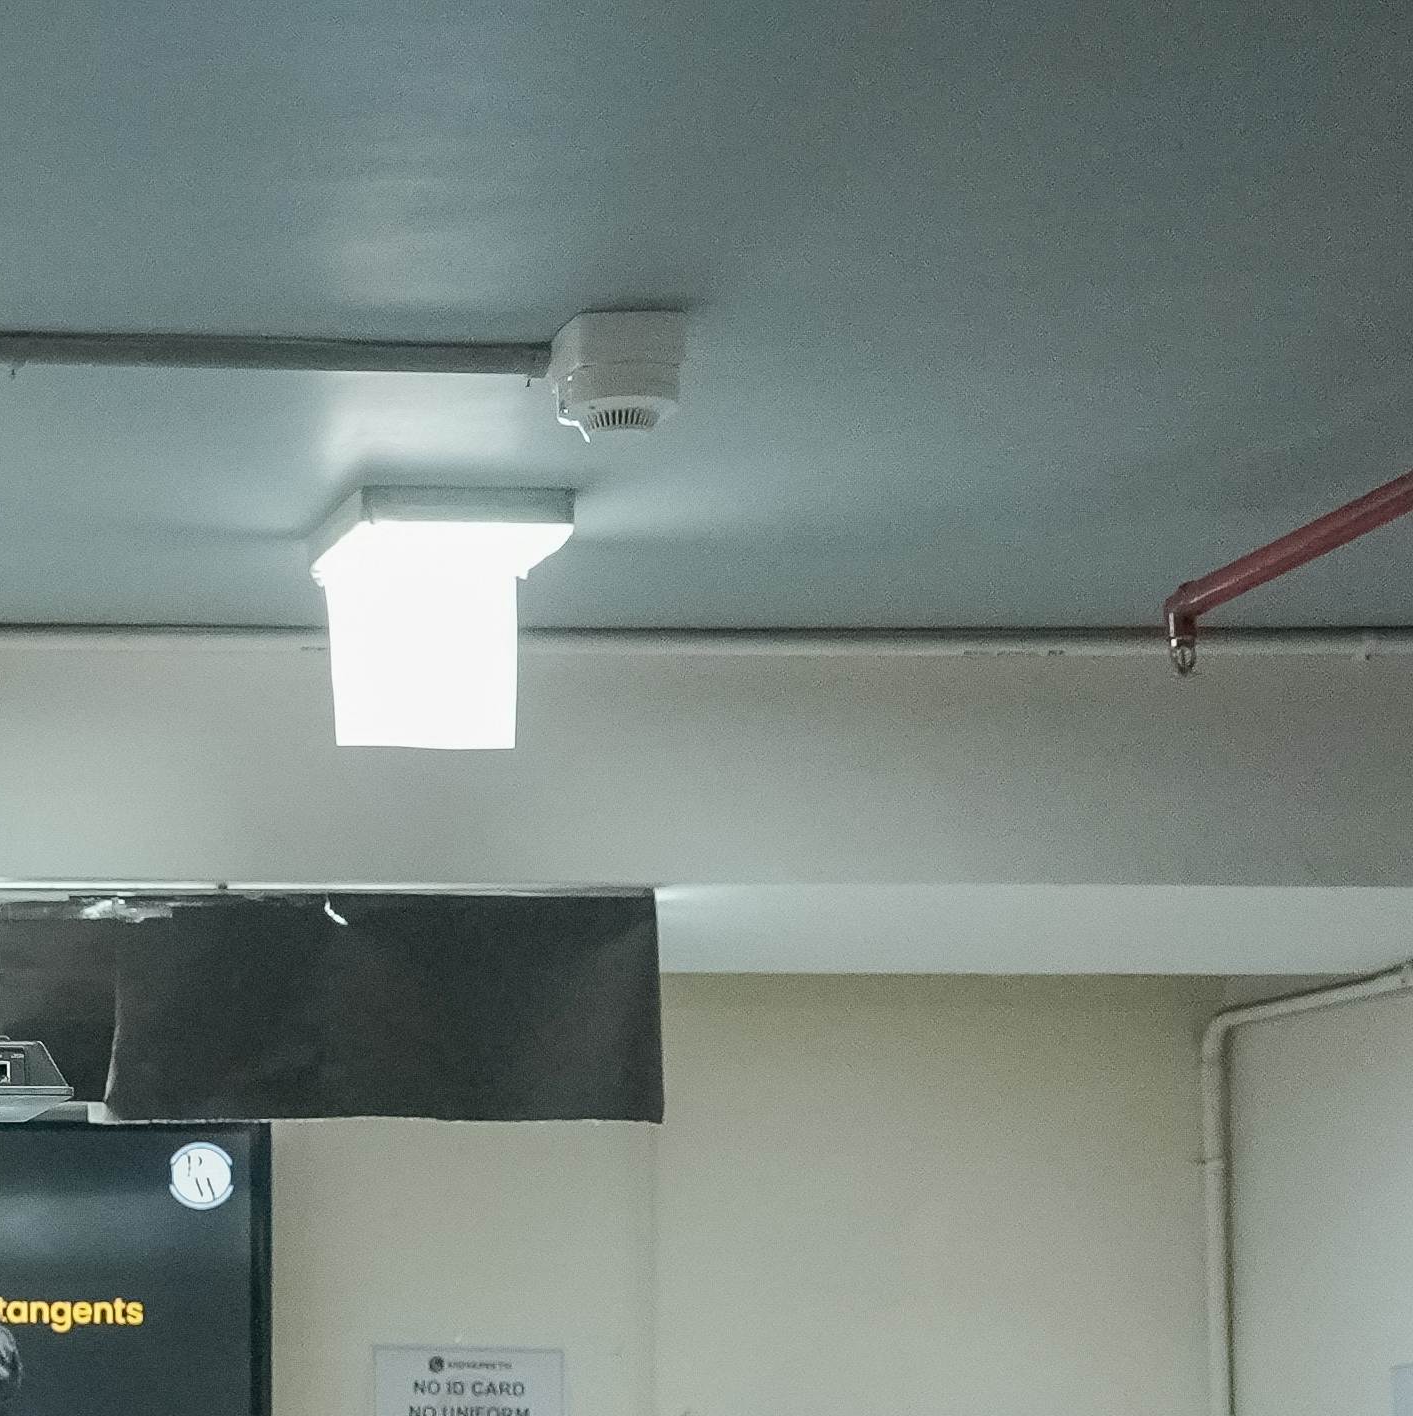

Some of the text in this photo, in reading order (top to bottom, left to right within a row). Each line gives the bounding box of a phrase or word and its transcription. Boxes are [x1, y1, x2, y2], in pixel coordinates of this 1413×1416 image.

[413, 1380, 525, 1398] NO ID CARD
